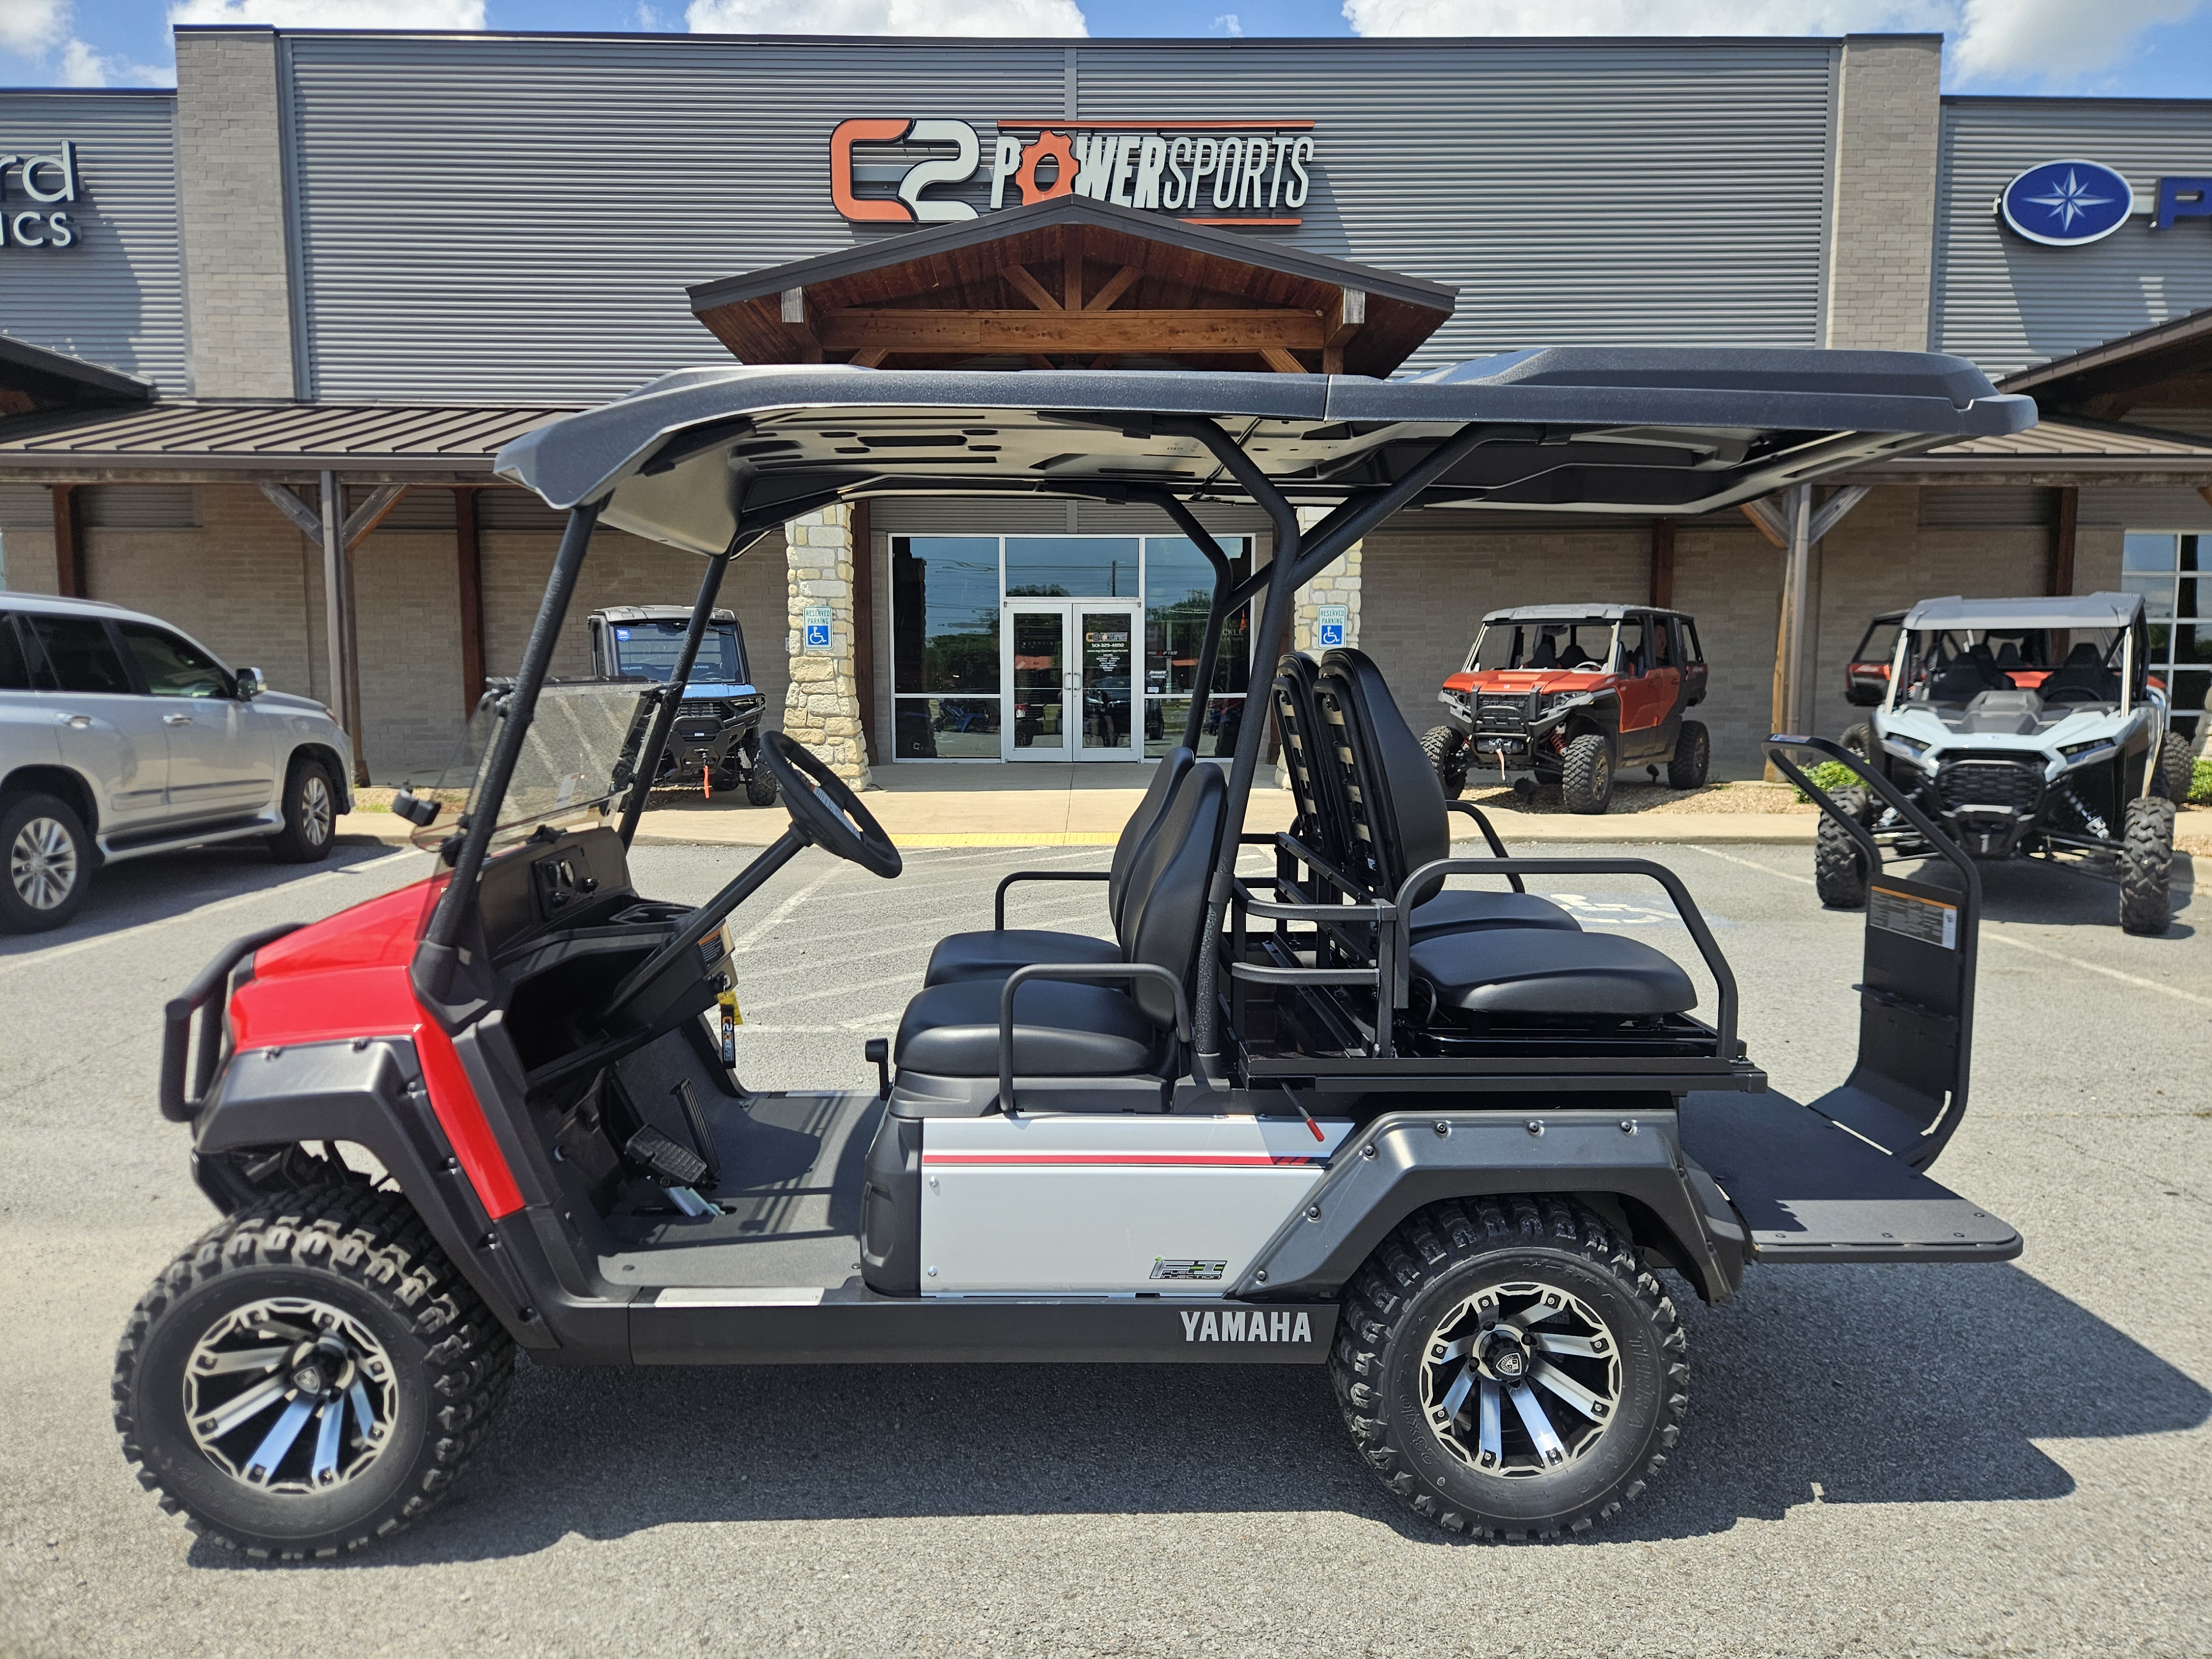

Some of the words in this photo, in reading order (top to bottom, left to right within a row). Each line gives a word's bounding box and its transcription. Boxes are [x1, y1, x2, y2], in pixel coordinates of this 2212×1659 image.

[830, 118, 980, 222] C2
[989, 130, 1315, 210] POWERSPORTS
[1180, 1311, 1312, 1342] YAMAHA
